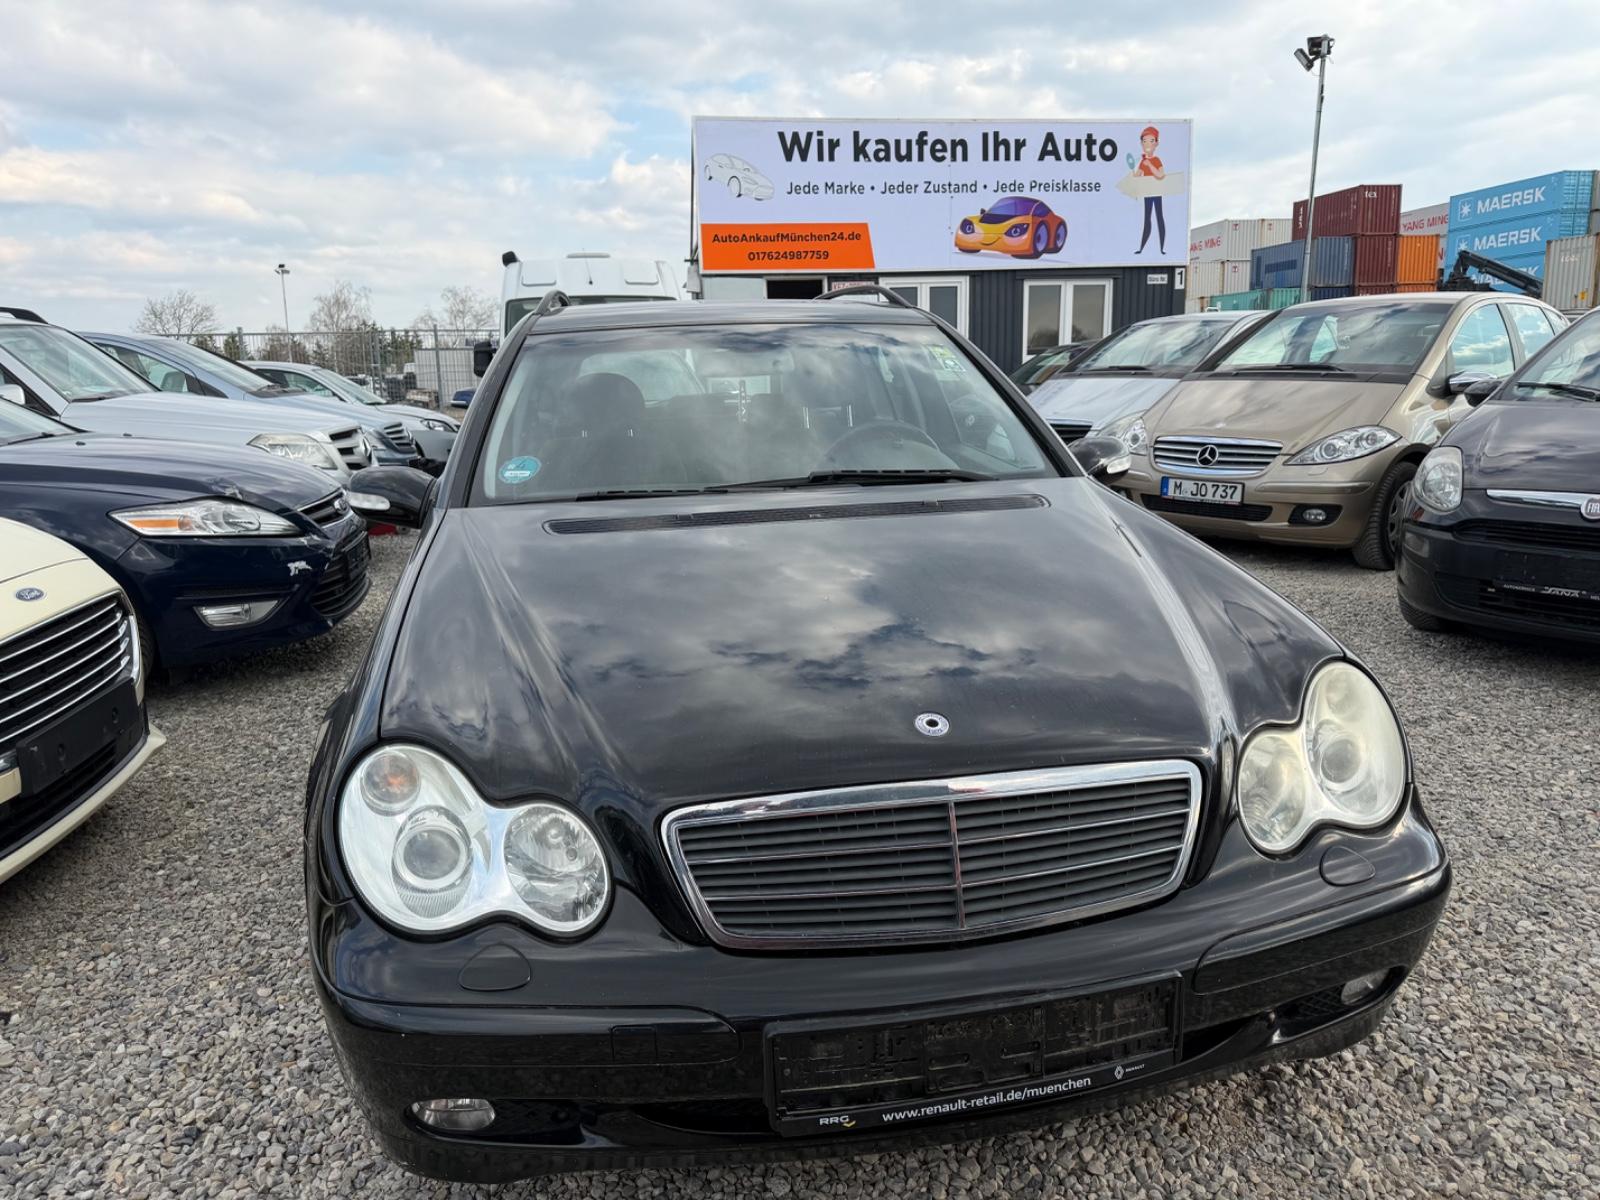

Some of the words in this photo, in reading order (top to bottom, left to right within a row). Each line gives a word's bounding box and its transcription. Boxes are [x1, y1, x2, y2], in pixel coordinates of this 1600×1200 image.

[777, 130, 841, 163] Wir
[852, 130, 969, 163] kaufen
[981, 130, 1027, 162] Ihr
[1037, 131, 1118, 163] Auto
[786, 181, 820, 195] Jede
[825, 181, 865, 194] Marke
[880, 181, 918, 194] Jeder
[923, 180, 978, 194] Zustand
[993, 180, 1025, 193] Jede
[1029, 179, 1102, 193] Preisklasse
[1476, 186, 1546, 214] MAERSK
[1402, 218, 1425, 231] YANG
[1427, 214, 1449, 228] MING
[711, 231, 862, 243] AutoAnkaufMünchen24.de
[1473, 226, 1542, 251] MAERSK
[747, 250, 830, 261] 017624987759
[1177, 269, 1184, 286] 1
[1173, 480, 1182, 495] M
[1190, 482, 1208, 497] JO
[1211, 484, 1238, 499] 737
[1587, 502, 1600, 513] FIA
[882, 1075, 1092, 1122] www.renault-retail.de/muenchen
[819, 1114, 849, 1126] RRG
